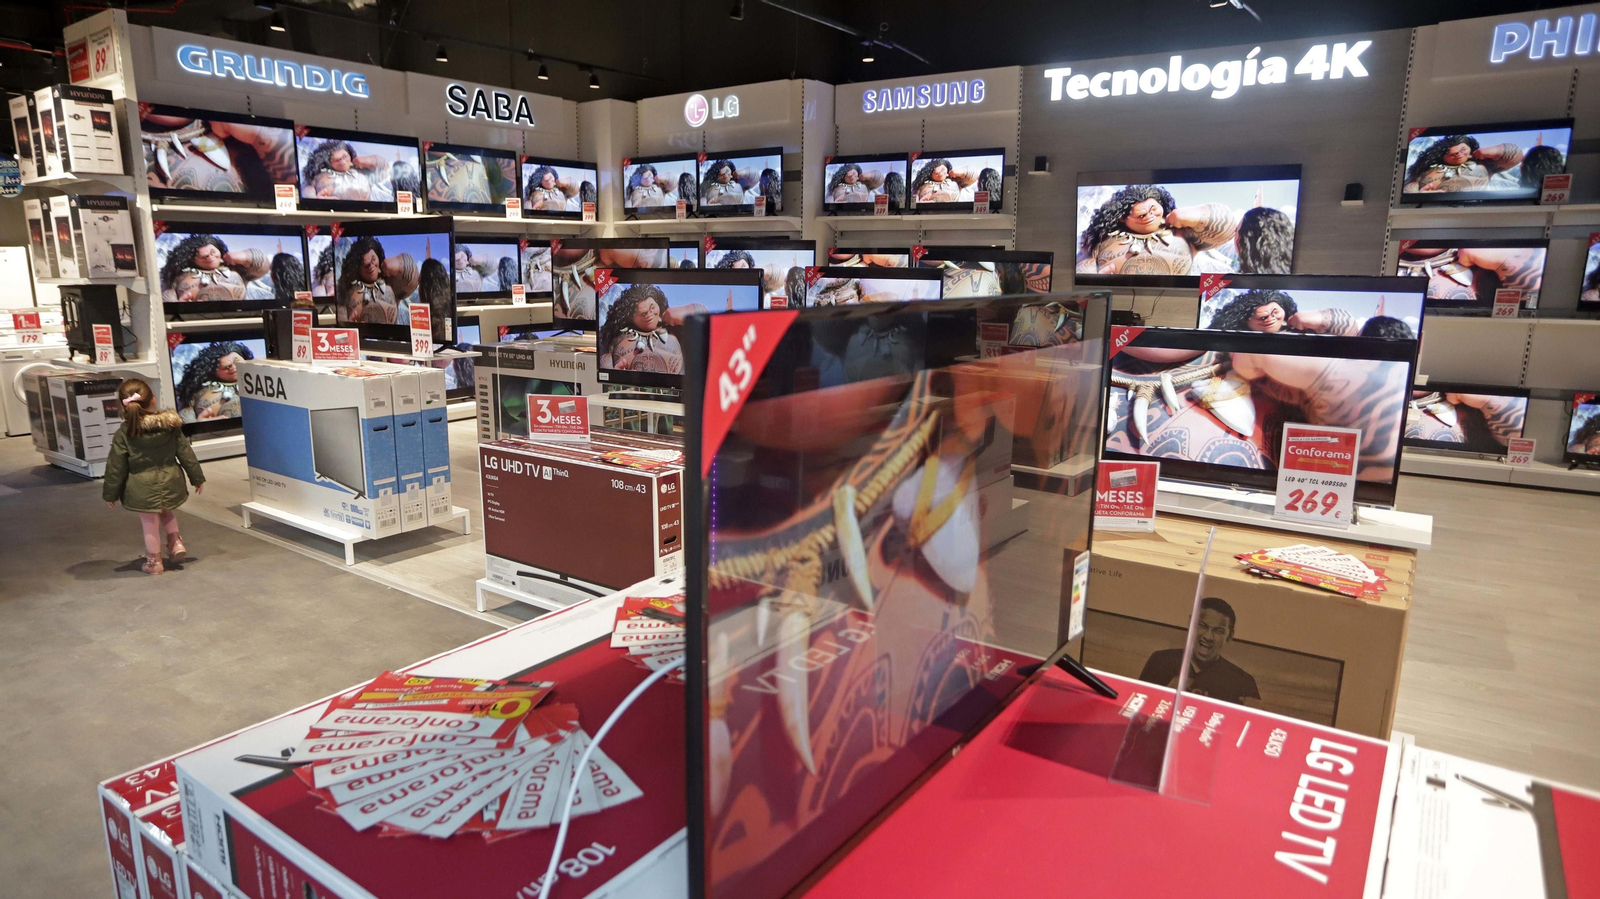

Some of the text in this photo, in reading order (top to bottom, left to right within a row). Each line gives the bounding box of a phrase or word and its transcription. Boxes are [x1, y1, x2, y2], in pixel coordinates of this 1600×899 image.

[1490, 14, 1600, 64] PHI
[177, 44, 370, 98] GRUNDIG
[1044, 40, 1373, 101] Tecnología 4K
[70, 90, 106, 100] HYUNDAI
[445, 83, 535, 127] SABA
[862, 79, 985, 113] SAMSUNG
[711, 95, 740, 119] LG
[1545, 193, 1565, 203] 269
[597, 270, 606, 285] 43"
[1203, 274, 1215, 288] 43"
[1208, 280, 1227, 297] UHD 4K
[1495, 307, 1515, 316] 269
[22, 335, 38, 344] 179
[317, 333, 354, 353] 3 MESES
[415, 339, 429, 353] 399
[1114, 329, 1133, 349] 40"
[297, 345, 307, 359] 89
[549, 359, 586, 371] HYUNDAI
[718, 324, 757, 413] 43"
[243, 372, 288, 400] SABA
[536, 399, 582, 425] 3 MESES
[1288, 445, 1352, 460] Conforama
[1510, 456, 1529, 464] 269
[484, 454, 498, 470] LG
[500, 458, 523, 475] UHD
[524, 462, 541, 478] TV
[553, 467, 569, 478] ThinQ
[610, 479, 624, 490] 108
[635, 483, 647, 494] 43
[667, 482, 676, 491] LG
[1095, 490, 1144, 504] MESES
[1284, 488, 1339, 516] 269
[1109, 569, 1123, 579] Life
[463, 703, 499, 712] TAE
[333, 715, 480, 733] Conforama
[1263, 727, 1288, 758] 43LK50
[1273, 736, 1359, 885] LG LED TV
[118, 827, 129, 849] LG
[112, 856, 127, 880] LED
[558, 841, 617, 879] 108
[157, 866, 172, 890] LG
